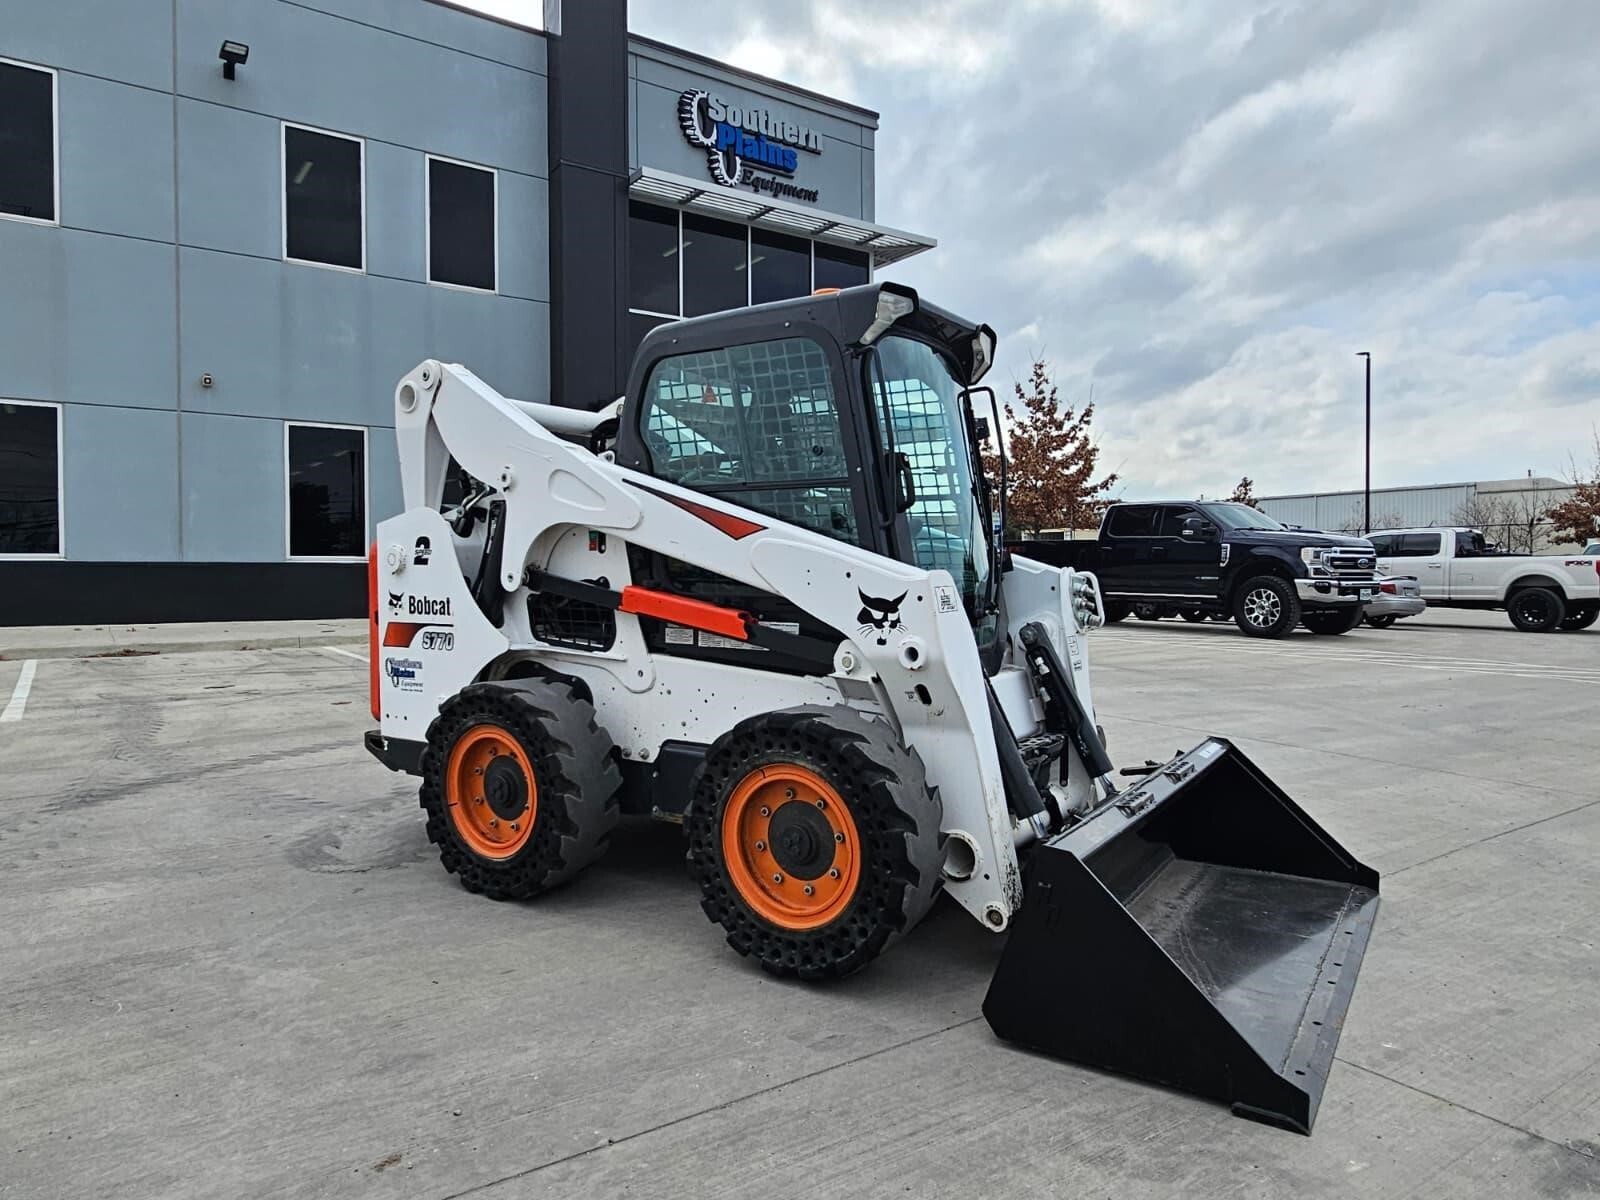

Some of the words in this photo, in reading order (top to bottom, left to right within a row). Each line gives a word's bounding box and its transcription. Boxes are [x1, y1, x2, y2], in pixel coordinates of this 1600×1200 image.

[707, 95, 823, 151] Southern
[716, 122, 798, 173] Plains
[741, 168, 819, 202] Equipment
[408, 595, 451, 616] Bobcat
[422, 632, 454, 650] S770
